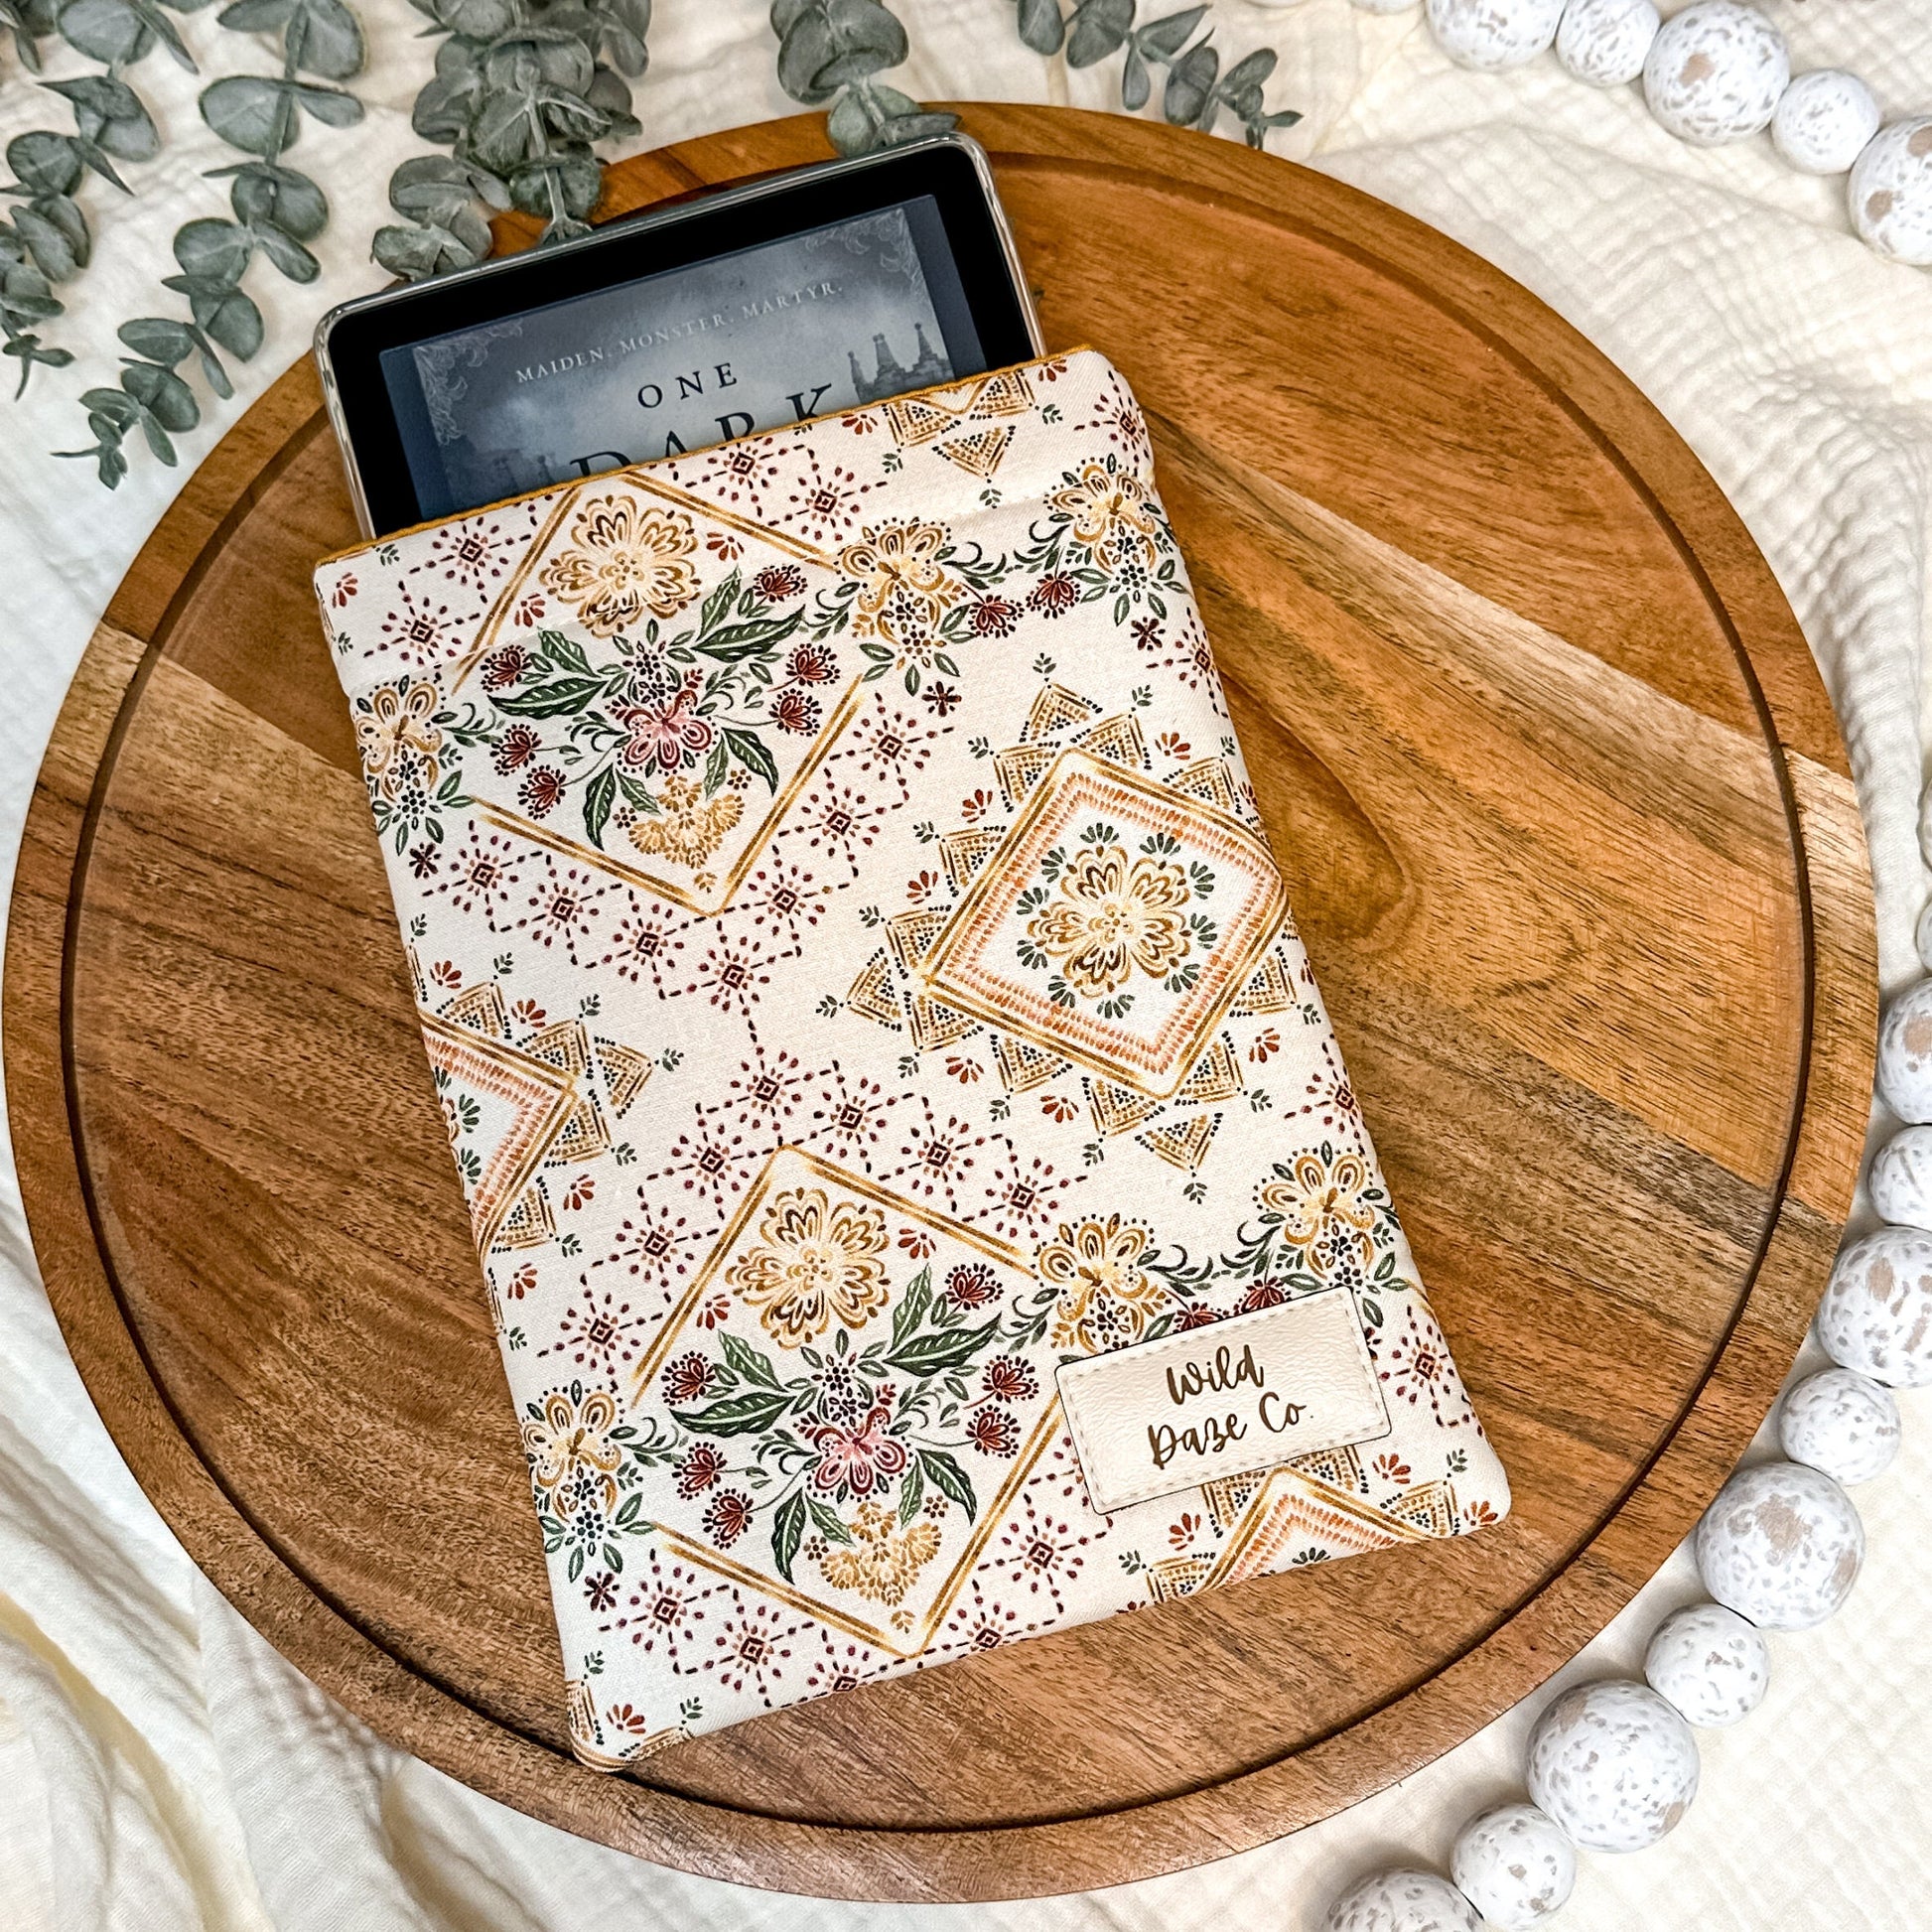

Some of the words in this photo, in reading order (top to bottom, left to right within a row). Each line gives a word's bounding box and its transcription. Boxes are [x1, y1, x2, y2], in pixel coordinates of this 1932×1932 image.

[619, 313, 735, 354] MONSTER.
[743, 282, 843, 319] MARTYR.
[637, 362, 738, 408] ONE
[1166, 1344, 1264, 1405] Wild
[1147, 1413, 1248, 1469] Daze
[1258, 1391, 1314, 1433] Co.
